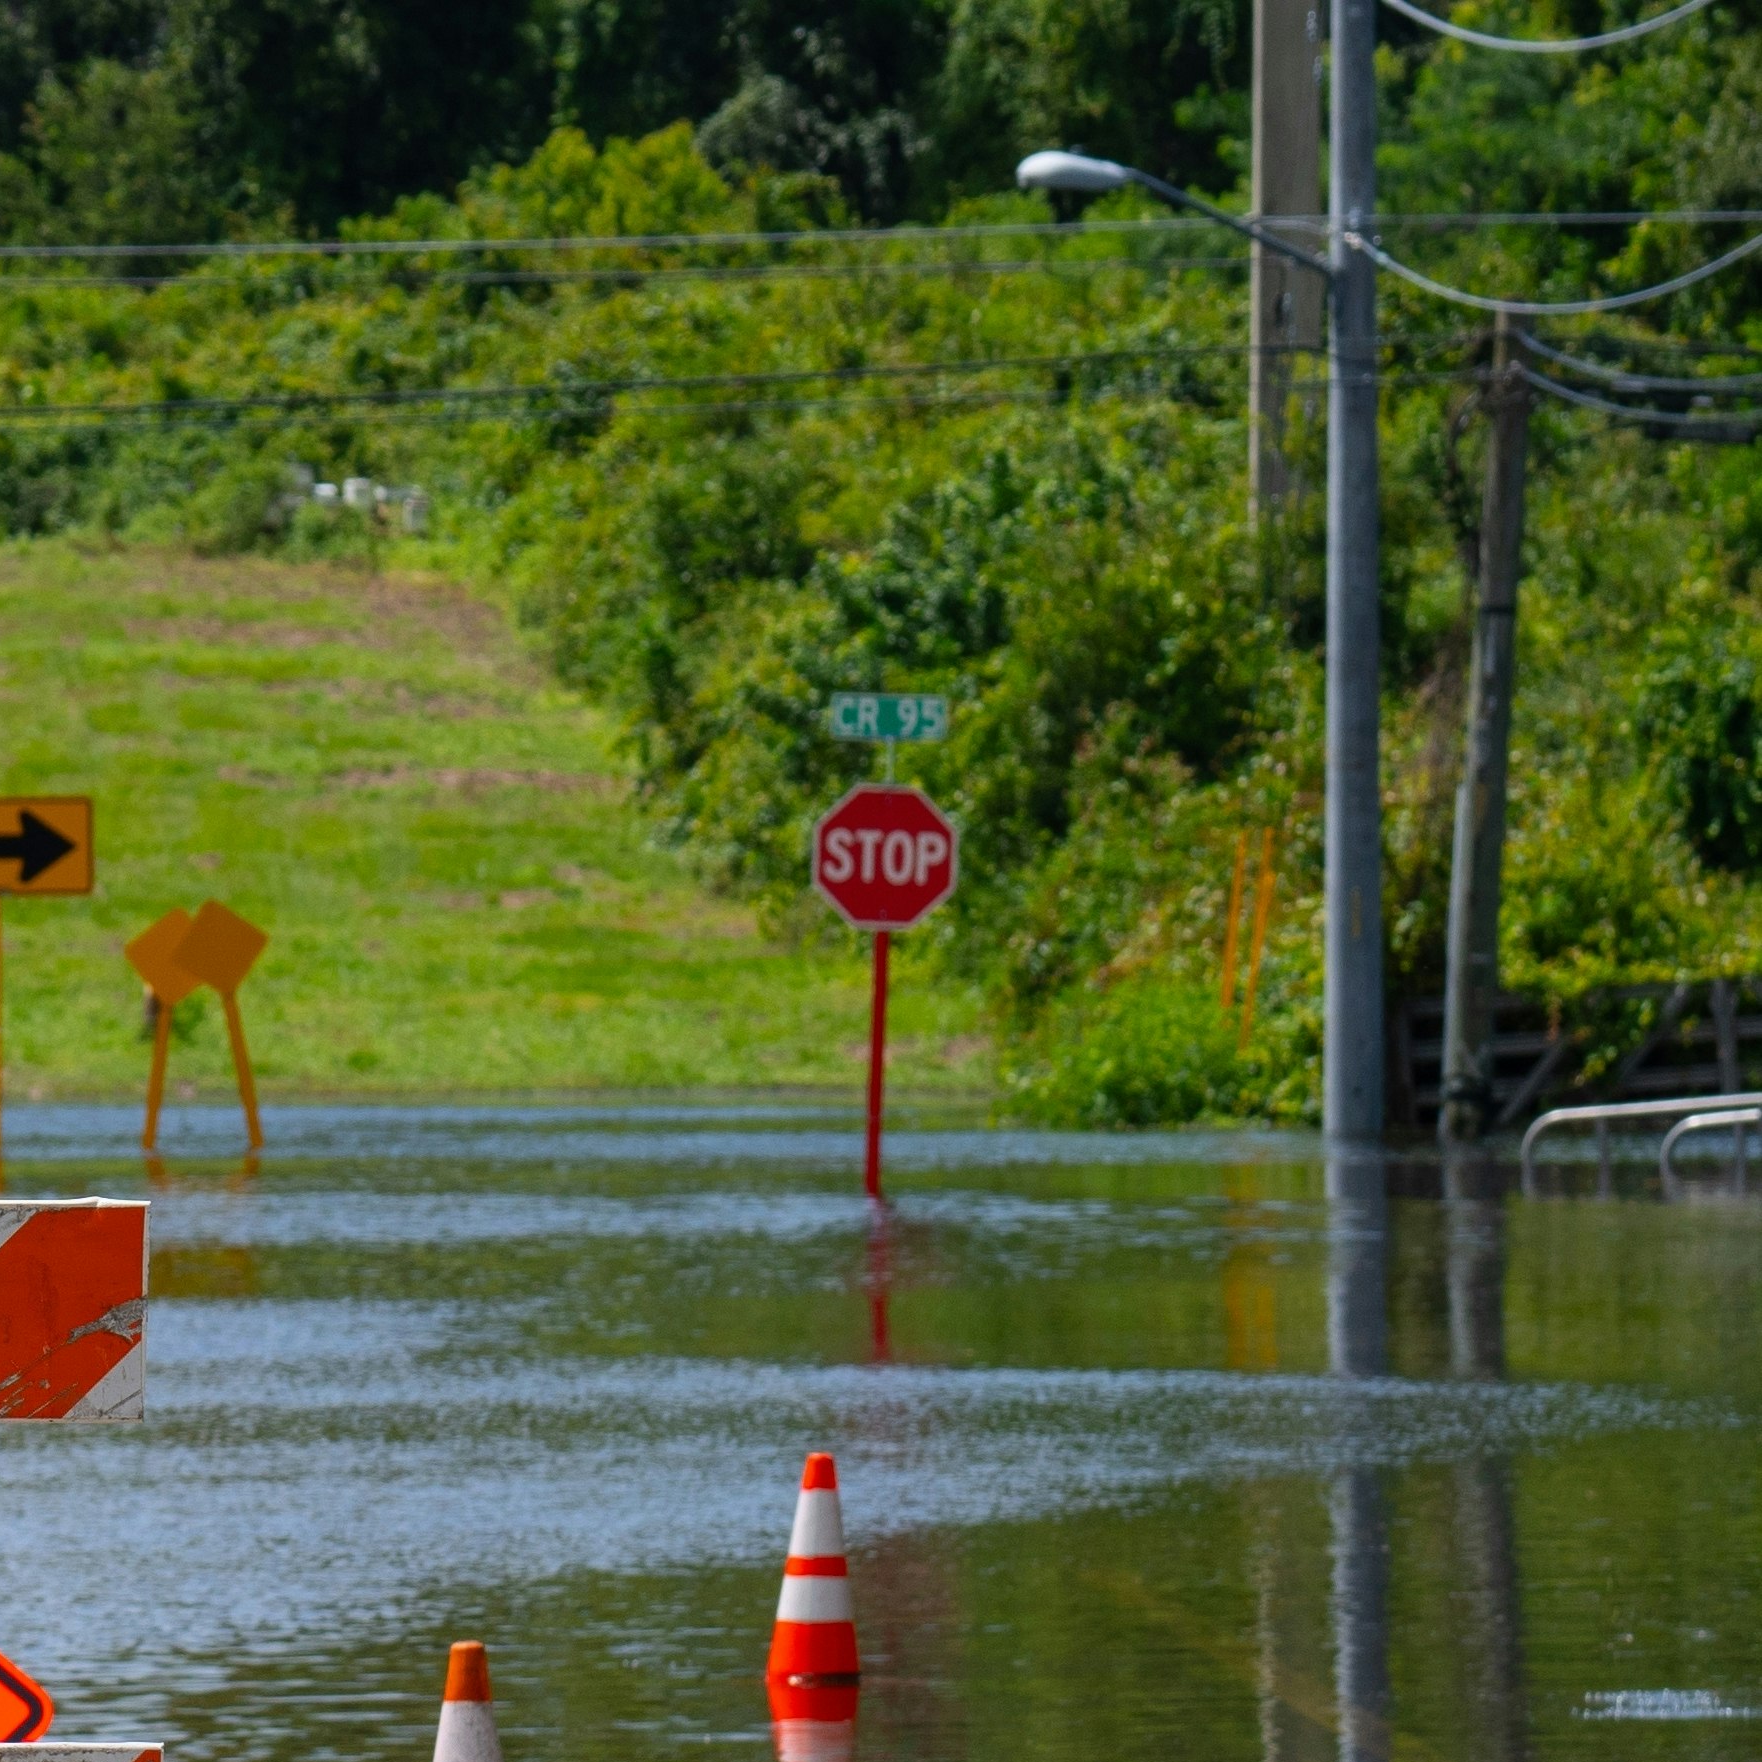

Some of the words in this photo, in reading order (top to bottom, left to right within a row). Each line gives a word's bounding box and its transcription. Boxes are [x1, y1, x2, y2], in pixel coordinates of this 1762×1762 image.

[833, 697, 878, 736] CR
[897, 697, 941, 737] 95
[823, 827, 948, 887] STOP
